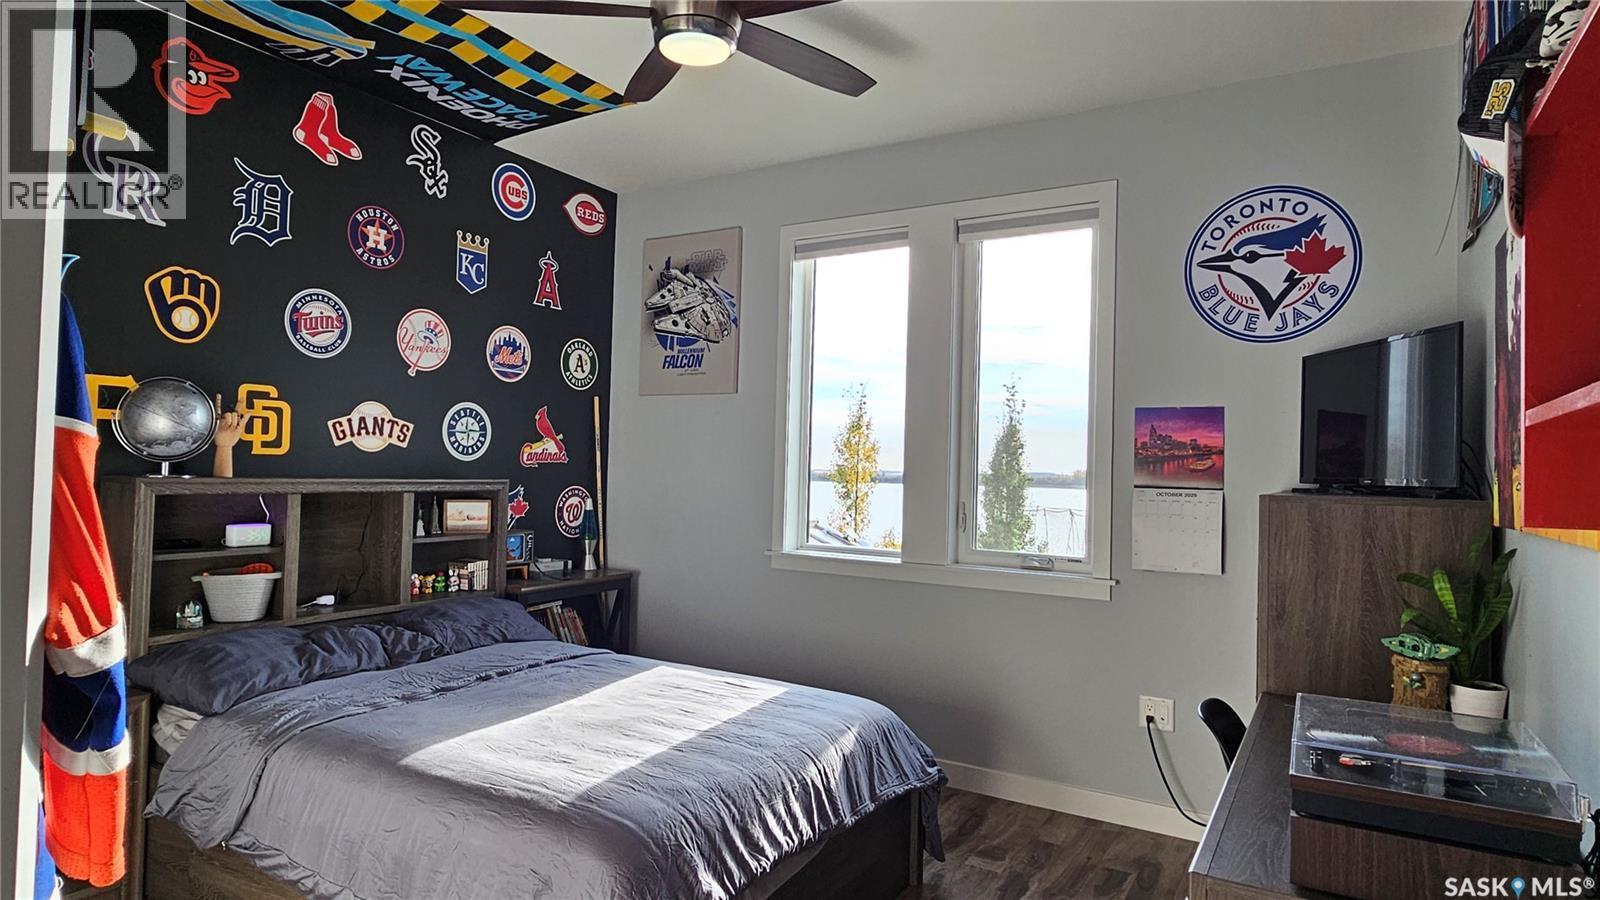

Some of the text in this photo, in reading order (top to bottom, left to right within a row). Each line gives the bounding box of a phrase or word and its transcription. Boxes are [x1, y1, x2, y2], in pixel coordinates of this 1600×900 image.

[372, 64, 540, 130] PHOENIX
[375, 53, 551, 121] RACEWAY
[355, 208, 399, 231] HOUSTON
[577, 206, 605, 224] REDS
[1201, 198, 1309, 252] TORONTO
[366, 225, 388, 251] H
[356, 247, 395, 266] ASTROS
[459, 252, 485, 285] KC
[295, 294, 343, 315] MINNESOTA
[1199, 280, 1340, 332] BLUE JAYS
[292, 311, 344, 337] Twins
[295, 334, 342, 353] BASEBALL CLUB
[399, 326, 448, 354] Yankees
[567, 342, 593, 357] OAKLAND
[494, 346, 523, 366] Mets
[662, 353, 705, 370] FALCON
[565, 371, 594, 387] ATHLETICS
[450, 409, 485, 426] SEATTLE
[331, 415, 411, 444] GIANTS
[449, 435, 485, 454] MARINERS
[520, 443, 569, 467] Cardinals
[566, 499, 583, 523] W
